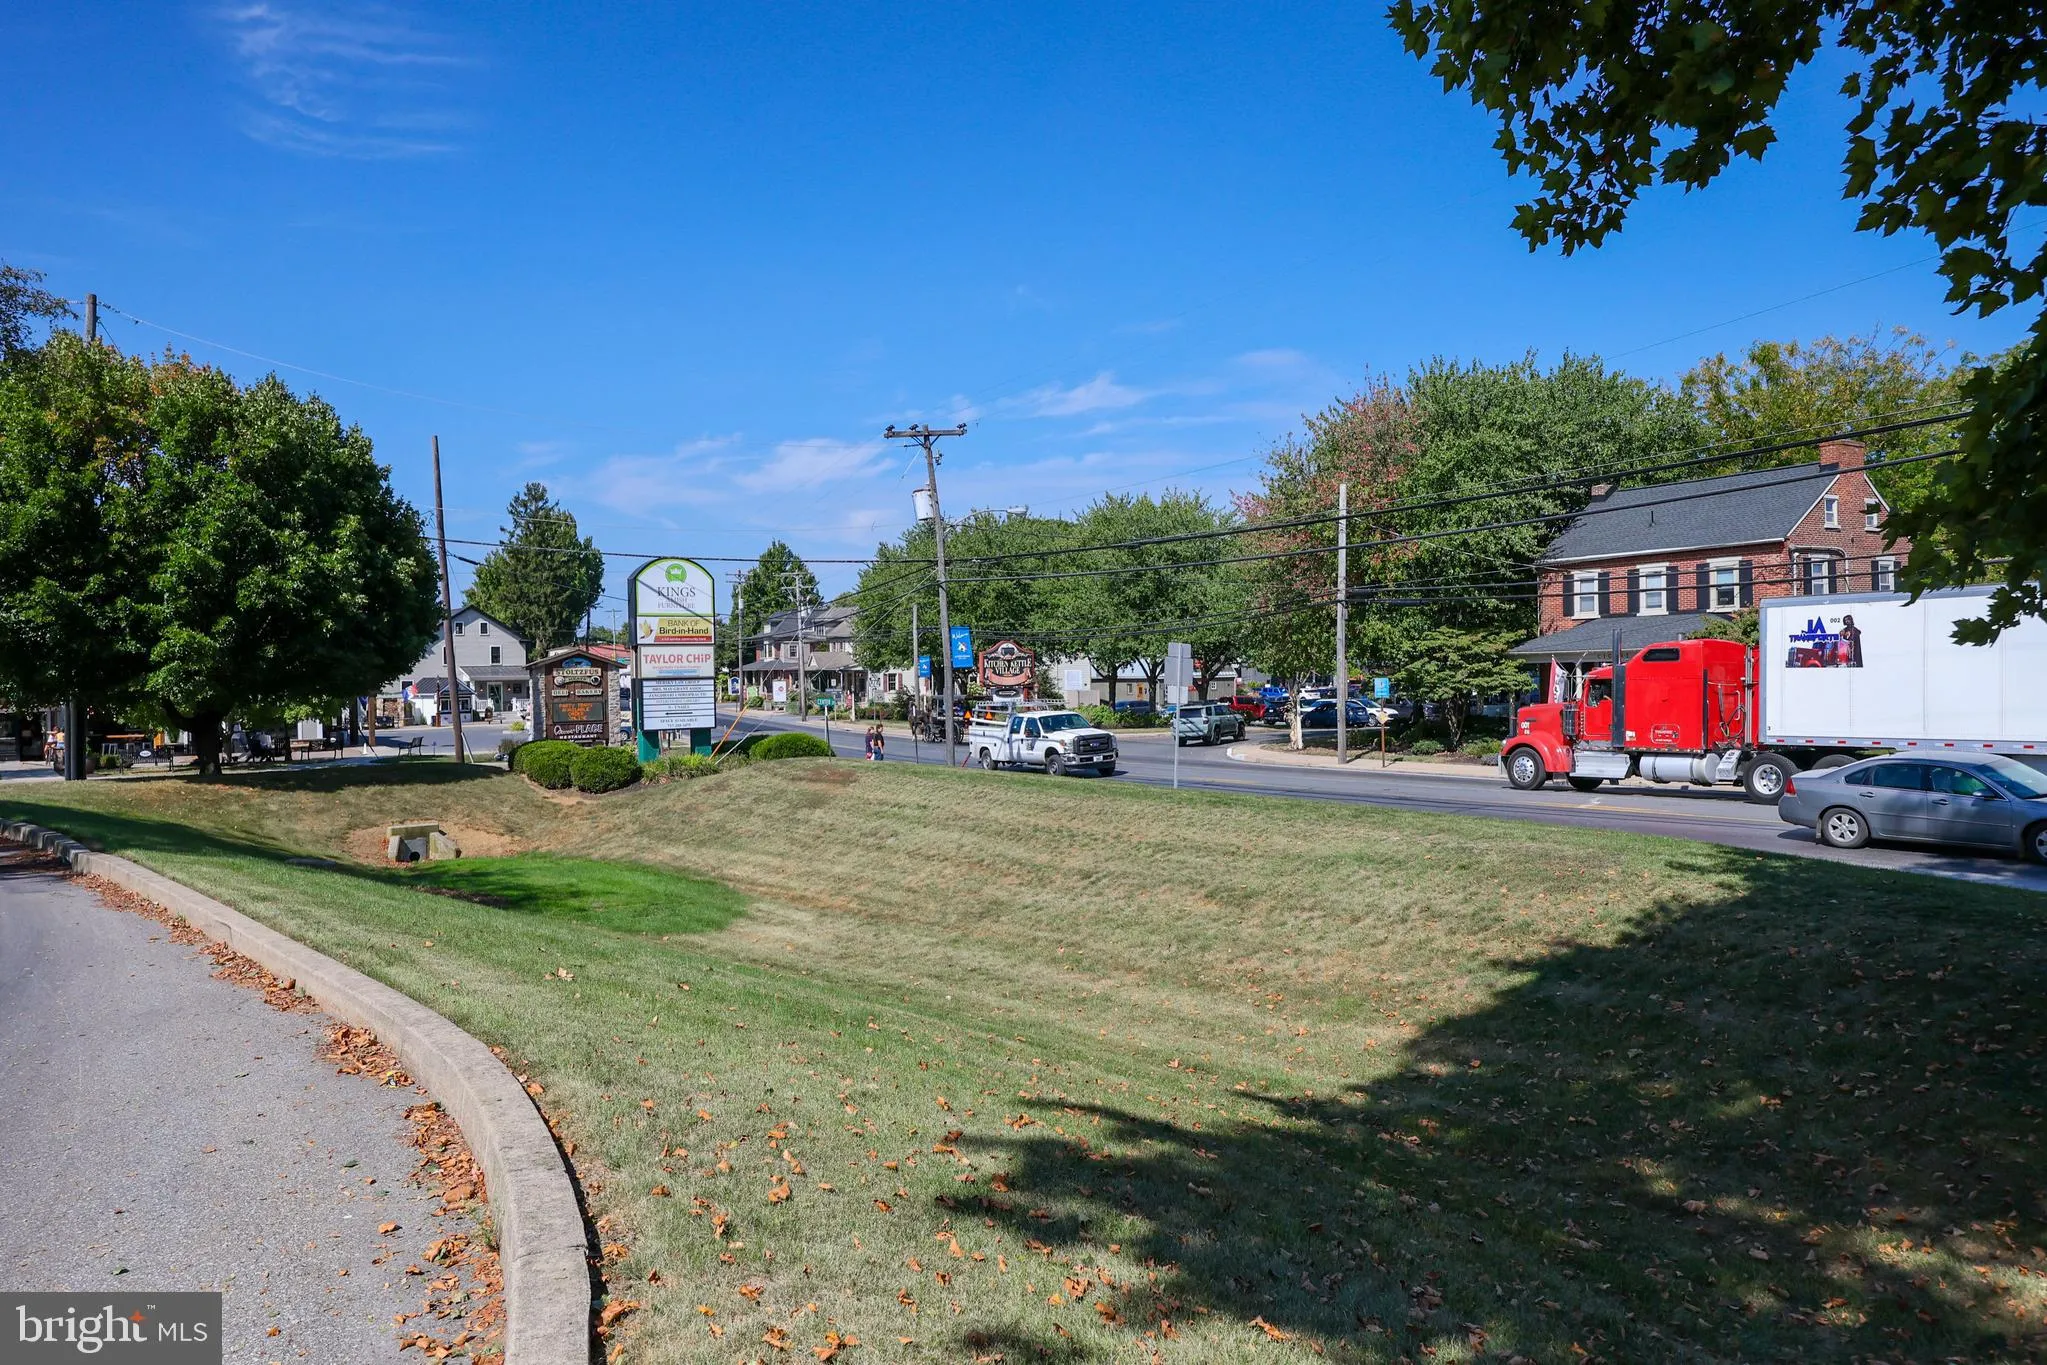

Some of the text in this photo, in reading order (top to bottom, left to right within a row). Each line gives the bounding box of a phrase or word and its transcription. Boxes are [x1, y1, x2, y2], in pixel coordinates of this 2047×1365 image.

[657, 586, 696, 597] KINGS
[659, 627, 709, 635] Bird-in-Hand
[643, 653, 711, 664] TAYLOR CHiP
[984, 657, 1032, 668] KITCHEN KETTLE
[995, 667, 1020, 675] VILLAGE
[575, 724, 603, 733] PLACE
